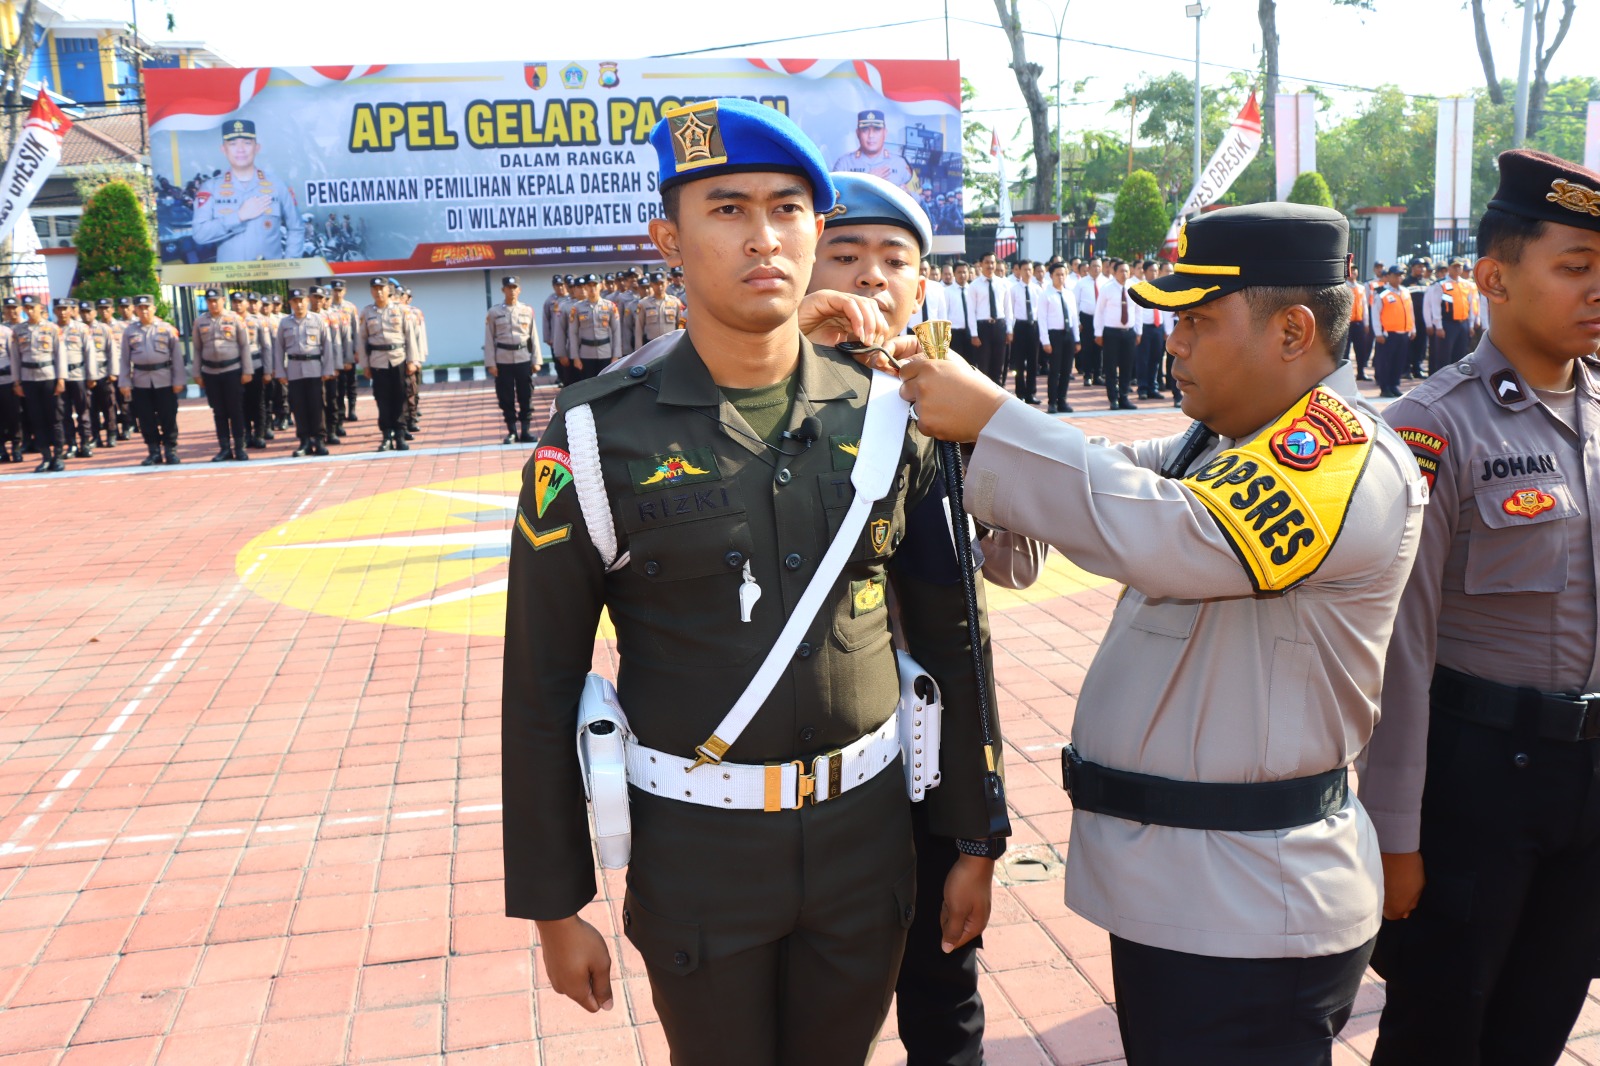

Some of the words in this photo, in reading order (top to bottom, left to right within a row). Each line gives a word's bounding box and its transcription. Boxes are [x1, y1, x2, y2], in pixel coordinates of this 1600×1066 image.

[350, 103, 457, 151] APEL
[466, 100, 599, 147] GELAR
[500, 152, 560, 168] DALAM
[567, 150, 636, 166] RANGKA
[1208, 133, 1251, 189] GRESIK
[307, 178, 418, 204] PENGAMANAN
[424, 175, 511, 199] PEMILIHAN
[517, 173, 575, 196] KEPALA
[580, 171, 641, 194] DAERAH
[447, 208, 463, 230] DI
[468, 206, 537, 229] WILAYAH
[543, 203, 632, 227] KABUPATEN
[503, 248, 528, 256] SPARTAN
[1318, 393, 1364, 435] POLRES
[538, 465, 565, 490] PM
[1481, 454, 1556, 481] JOHAN
[638, 487, 730, 521] RIZKI
